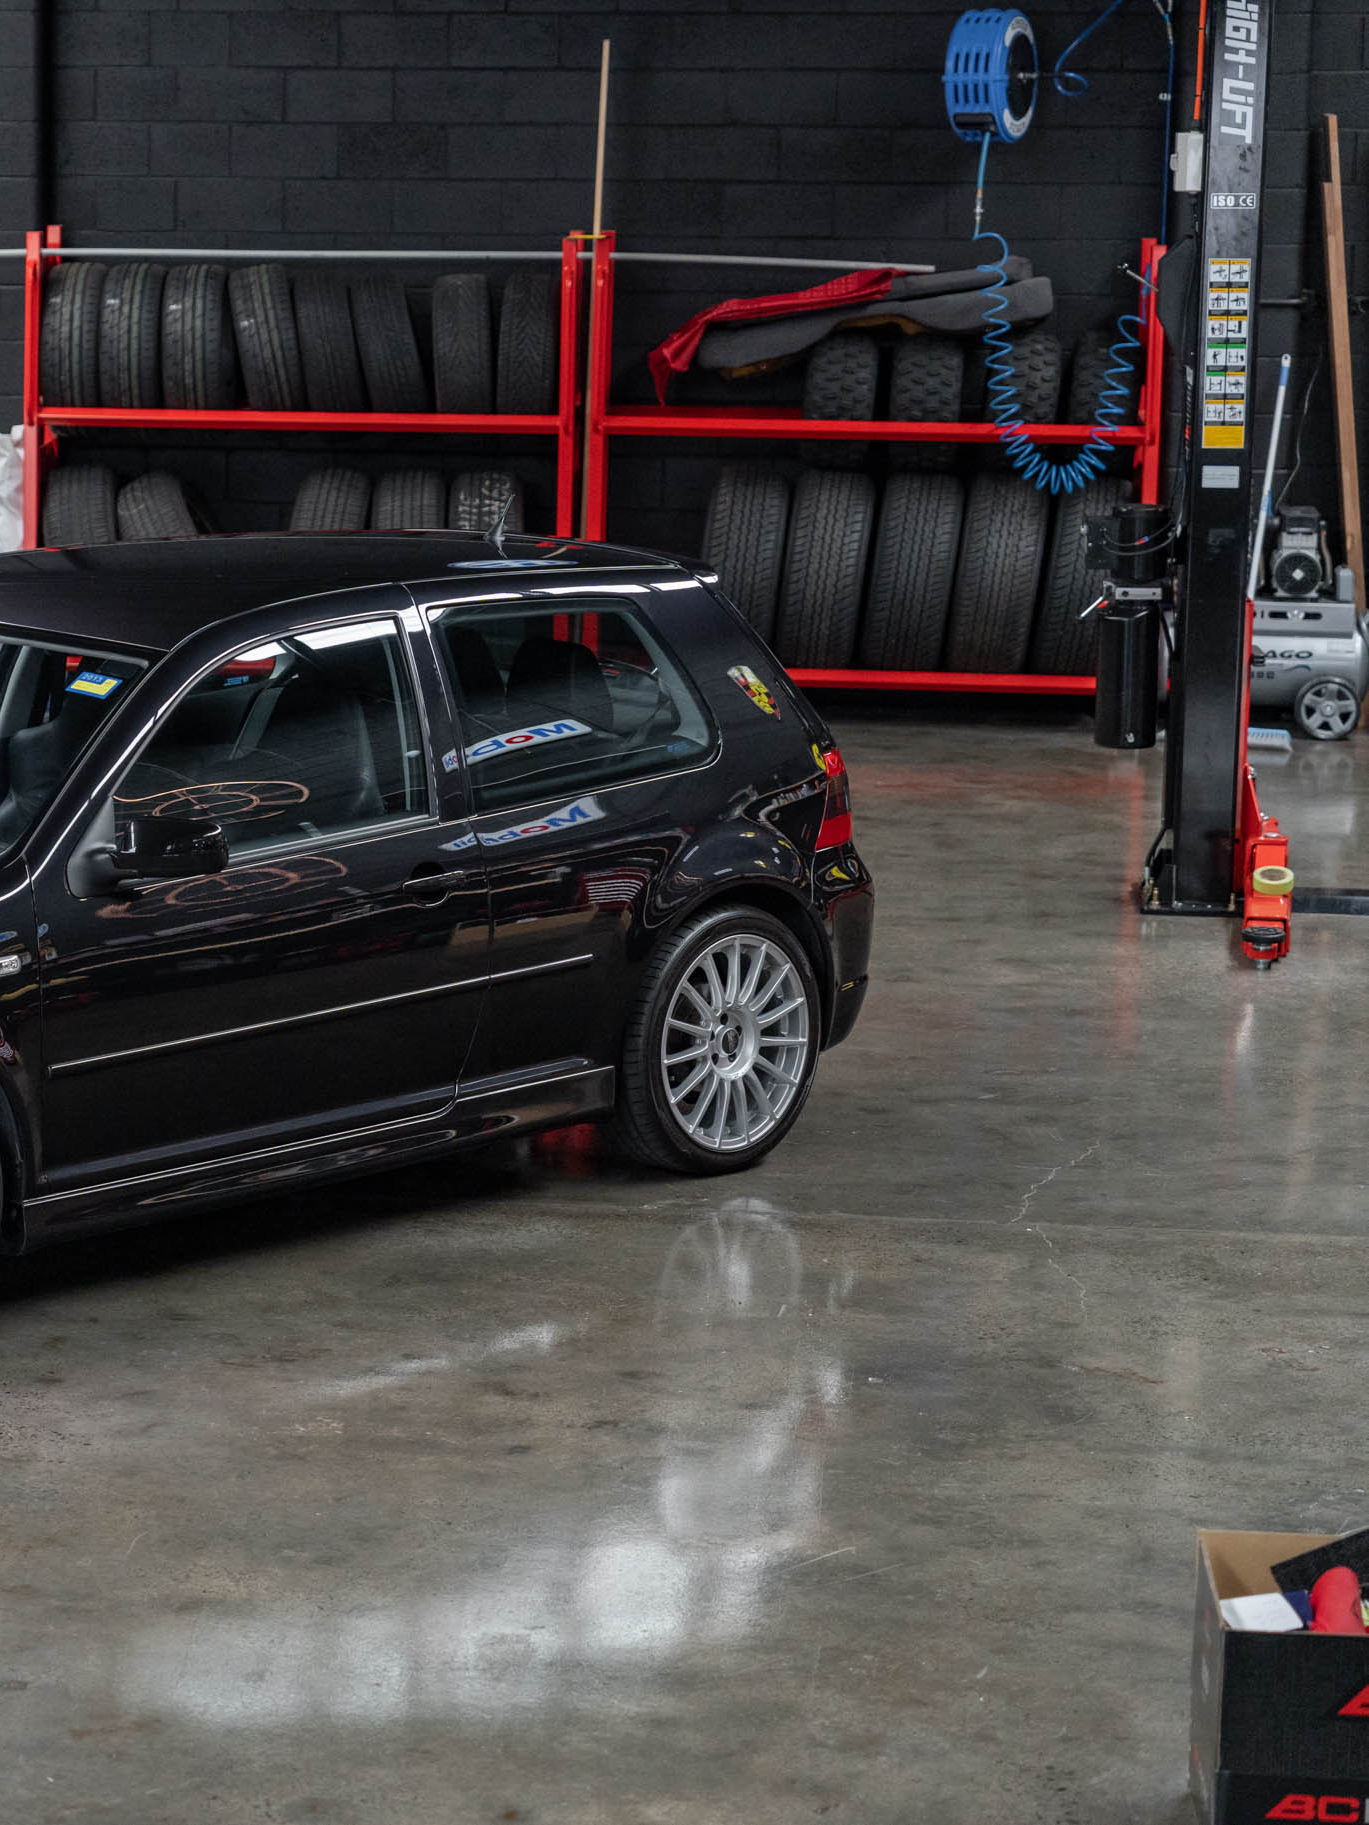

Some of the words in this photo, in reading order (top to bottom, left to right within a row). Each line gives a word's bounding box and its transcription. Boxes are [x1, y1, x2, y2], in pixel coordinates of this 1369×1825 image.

[1213, 195, 1236, 207] ISO
[1239, 195, 1254, 207] CE
[1264, 650, 1313, 659] AGO
